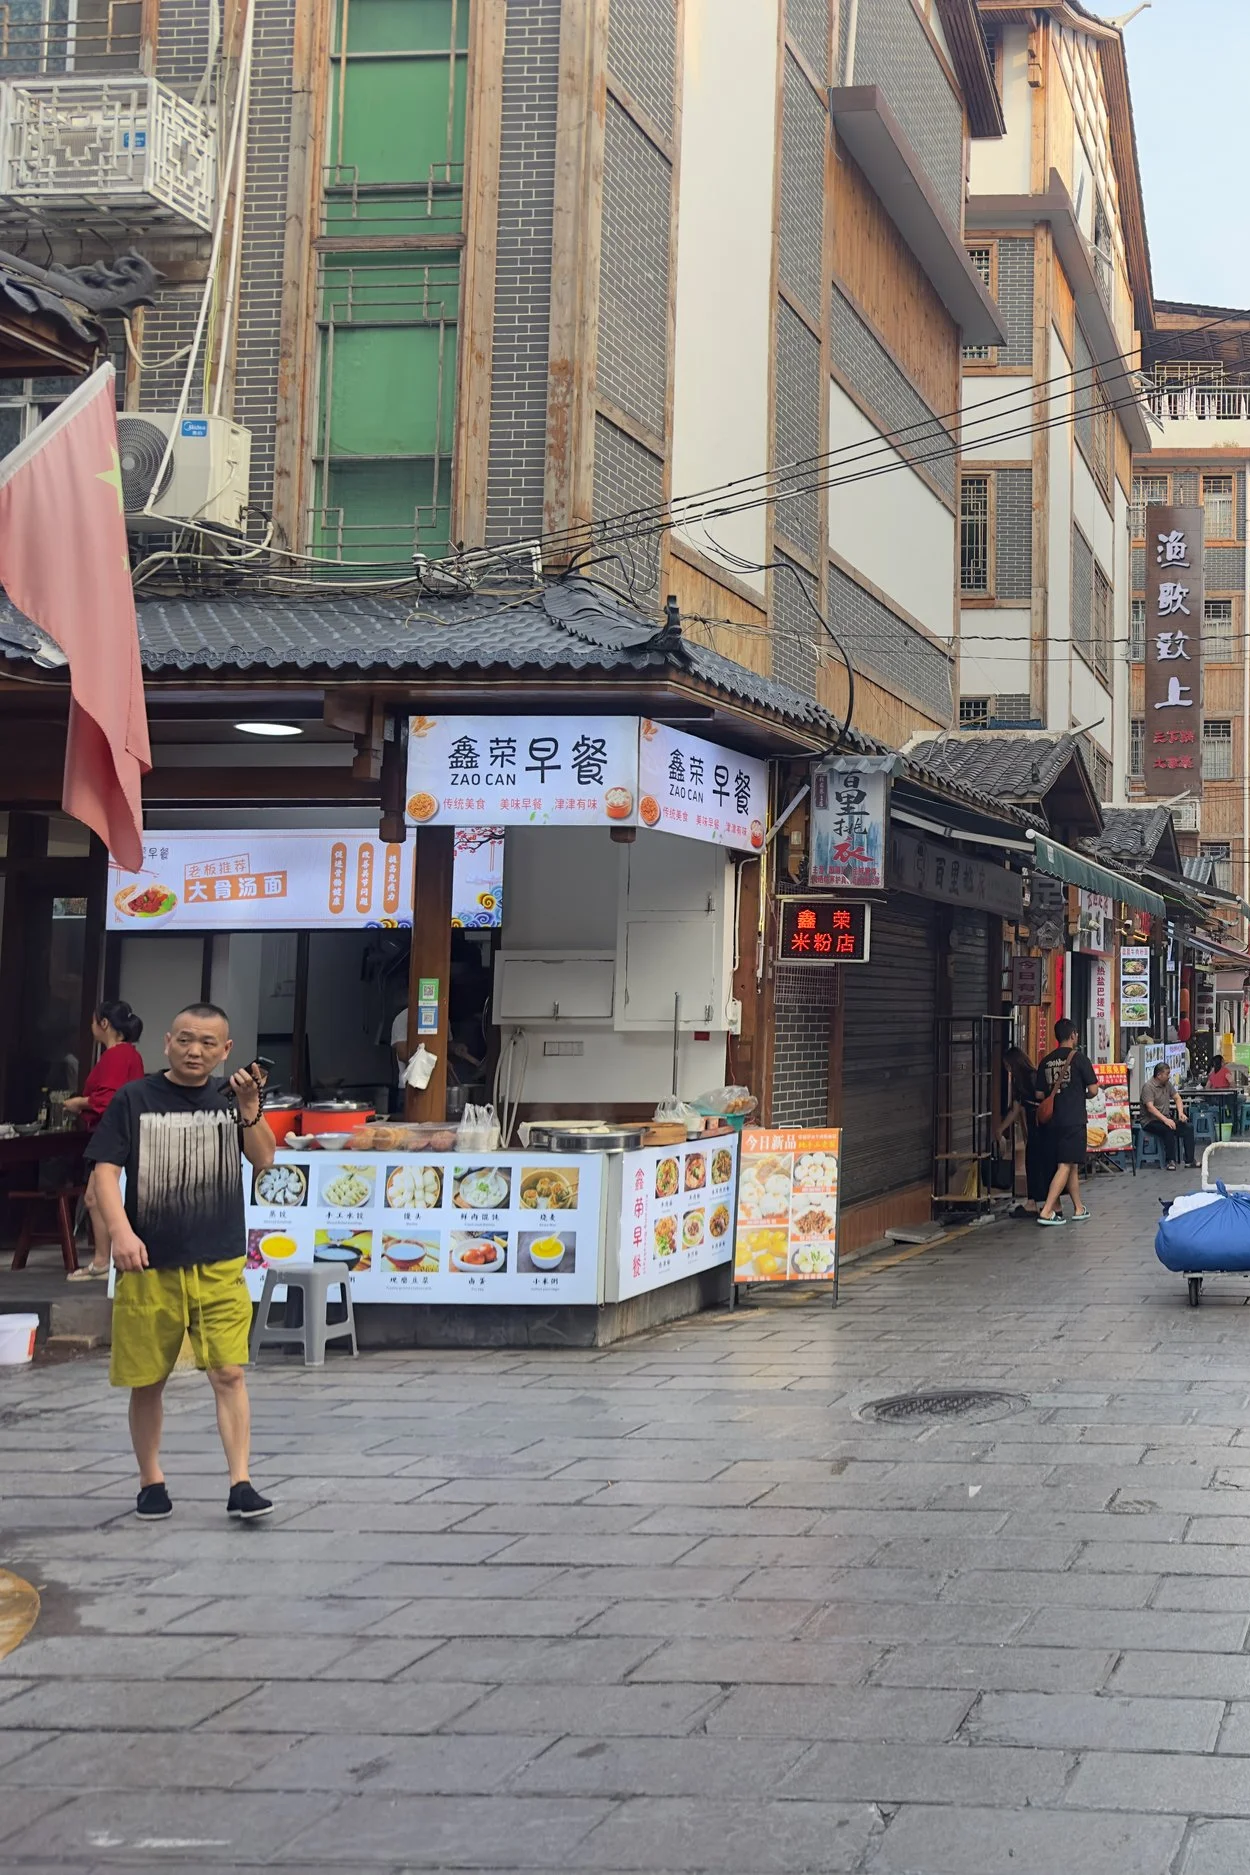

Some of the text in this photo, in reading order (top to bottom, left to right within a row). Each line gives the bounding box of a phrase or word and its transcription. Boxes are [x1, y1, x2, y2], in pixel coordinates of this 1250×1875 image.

[448, 734, 608, 786] 鑫荣早餐
[451, 773, 516, 786] ZAO CAN
[668, 748, 751, 816] 鑫荣早餐
[669, 784, 704, 804] ZAO CAN
[443, 798, 598, 811] 传统美食 美味早餐 津津有味
[188, 859, 247, 878] 老板推荐
[387, 855, 398, 901] 提高免疫力
[188, 874, 282, 901] 大骨汤面
[797, 909, 851, 929] 鑫荣
[791, 933, 855, 953] 米粉店
[745, 1133, 797, 1151] 今日新品
